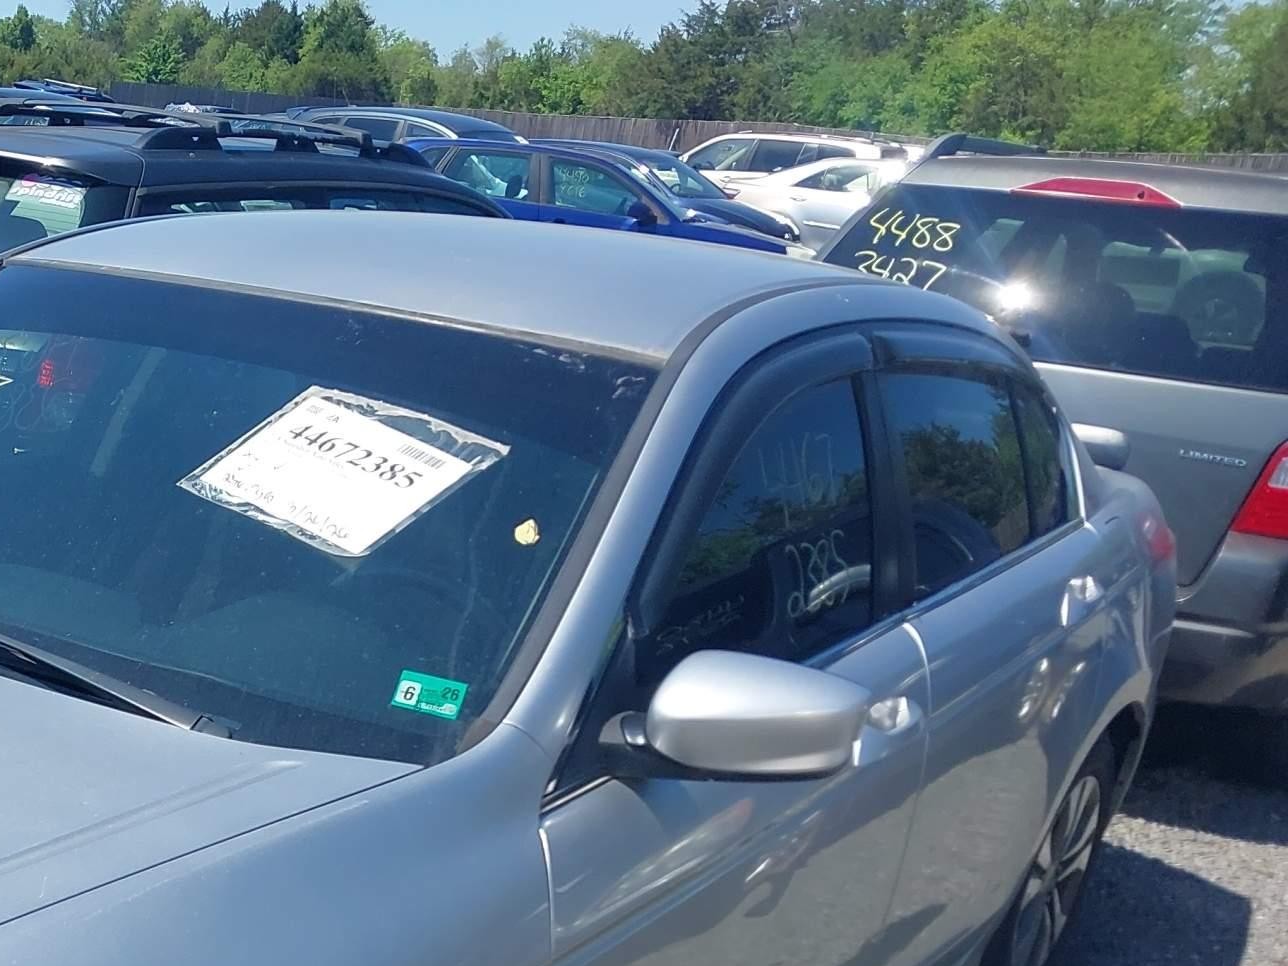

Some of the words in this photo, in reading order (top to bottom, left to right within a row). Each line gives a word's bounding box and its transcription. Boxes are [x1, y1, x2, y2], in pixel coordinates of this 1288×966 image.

[870, 207, 961, 251] 4488
[288, 424, 423, 488] 44672385
[1179, 449, 1247, 467] LIMITED
[404, 686, 416, 701] 6
[441, 687, 460, 701] 26
